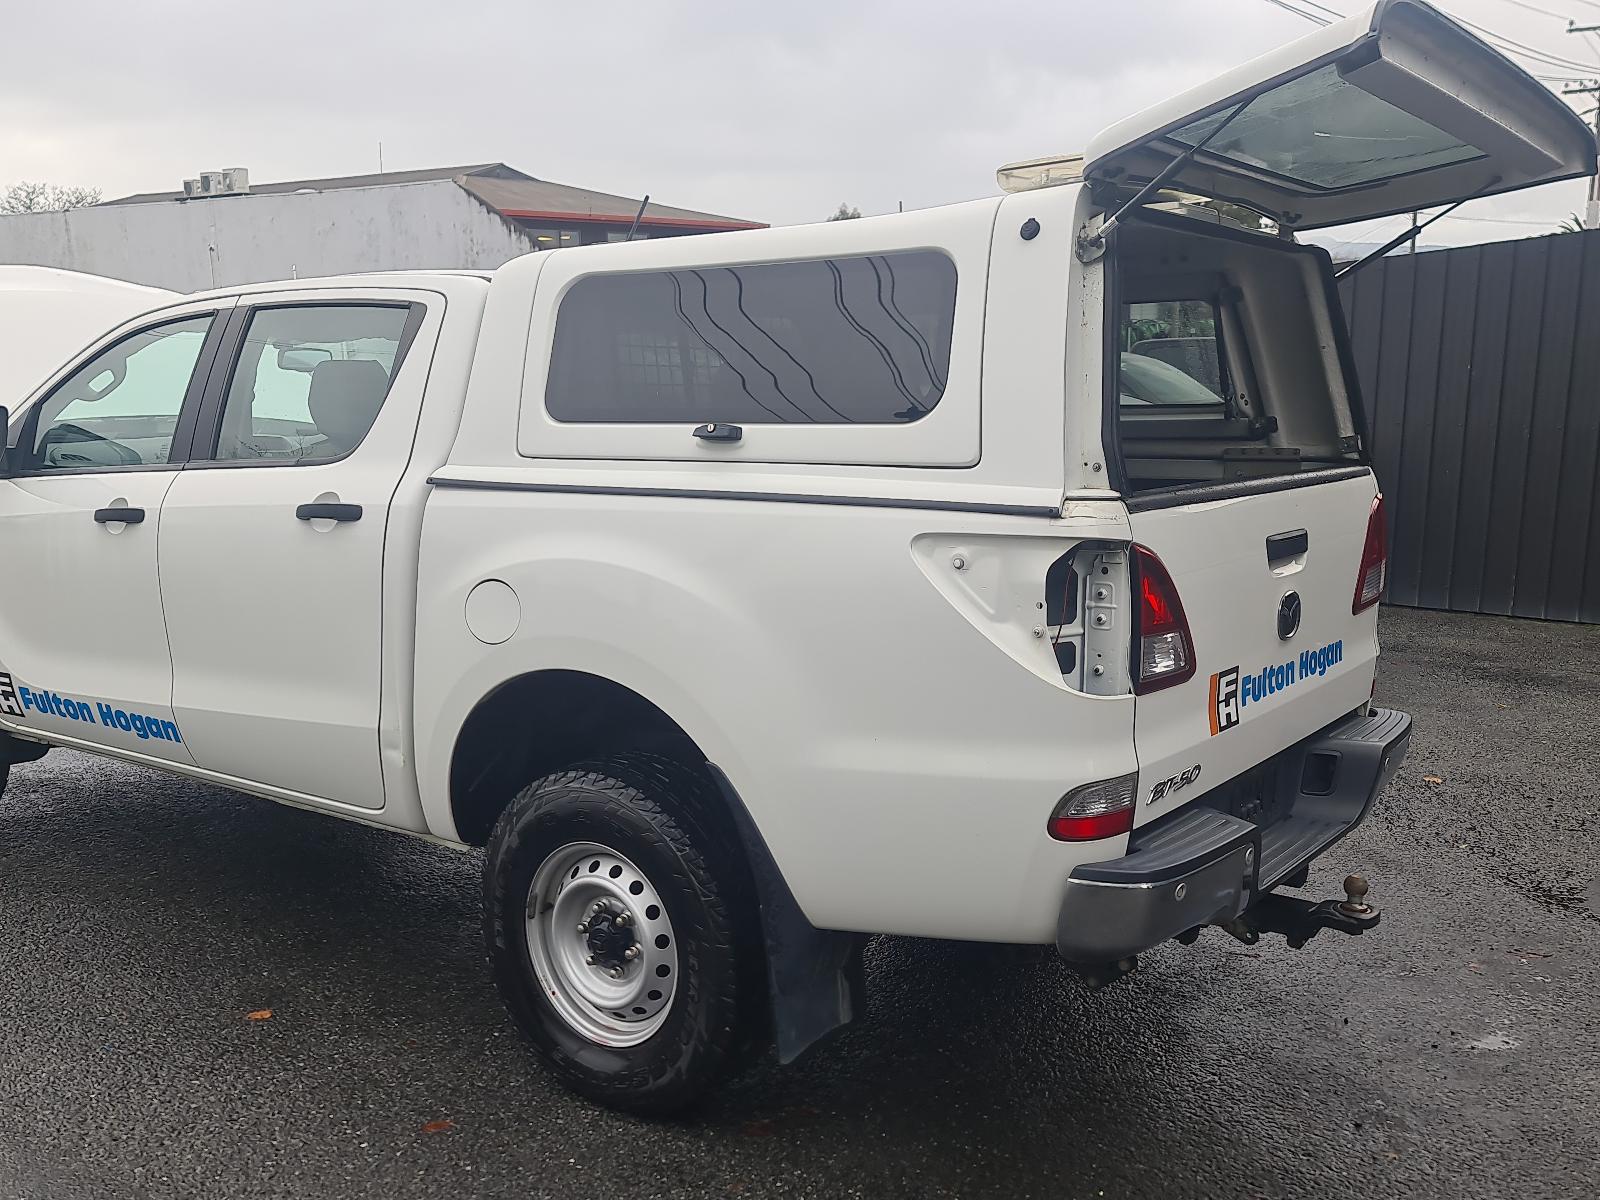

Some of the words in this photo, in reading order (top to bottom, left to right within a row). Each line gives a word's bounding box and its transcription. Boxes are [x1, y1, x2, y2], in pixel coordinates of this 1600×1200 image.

[1241, 660, 1295, 707] Fulton
[1299, 639, 1343, 680] Hogan
[18, 686, 96, 724] Fulton
[96, 702, 182, 744] Hogan
[1146, 763, 1202, 806] BT-50
